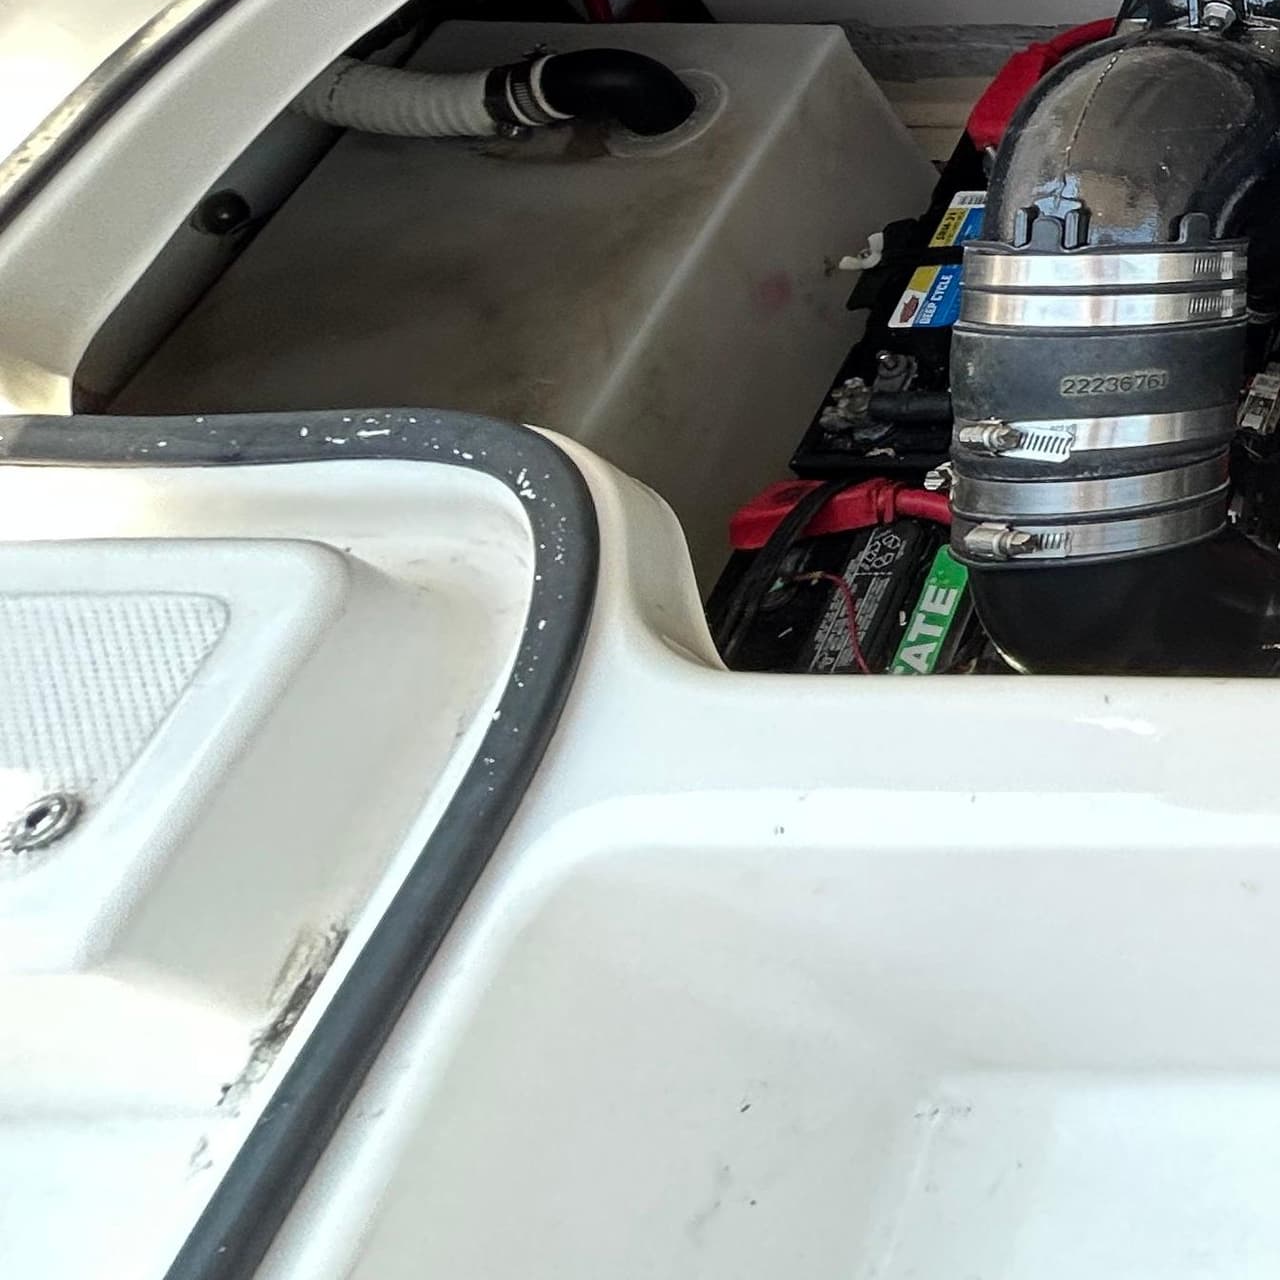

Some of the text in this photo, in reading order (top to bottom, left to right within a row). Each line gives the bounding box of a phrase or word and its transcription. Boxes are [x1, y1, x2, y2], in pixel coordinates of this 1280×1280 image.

[919, 274, 953, 324] DEEP CYCLE
[893, 585, 958, 674] ATE
